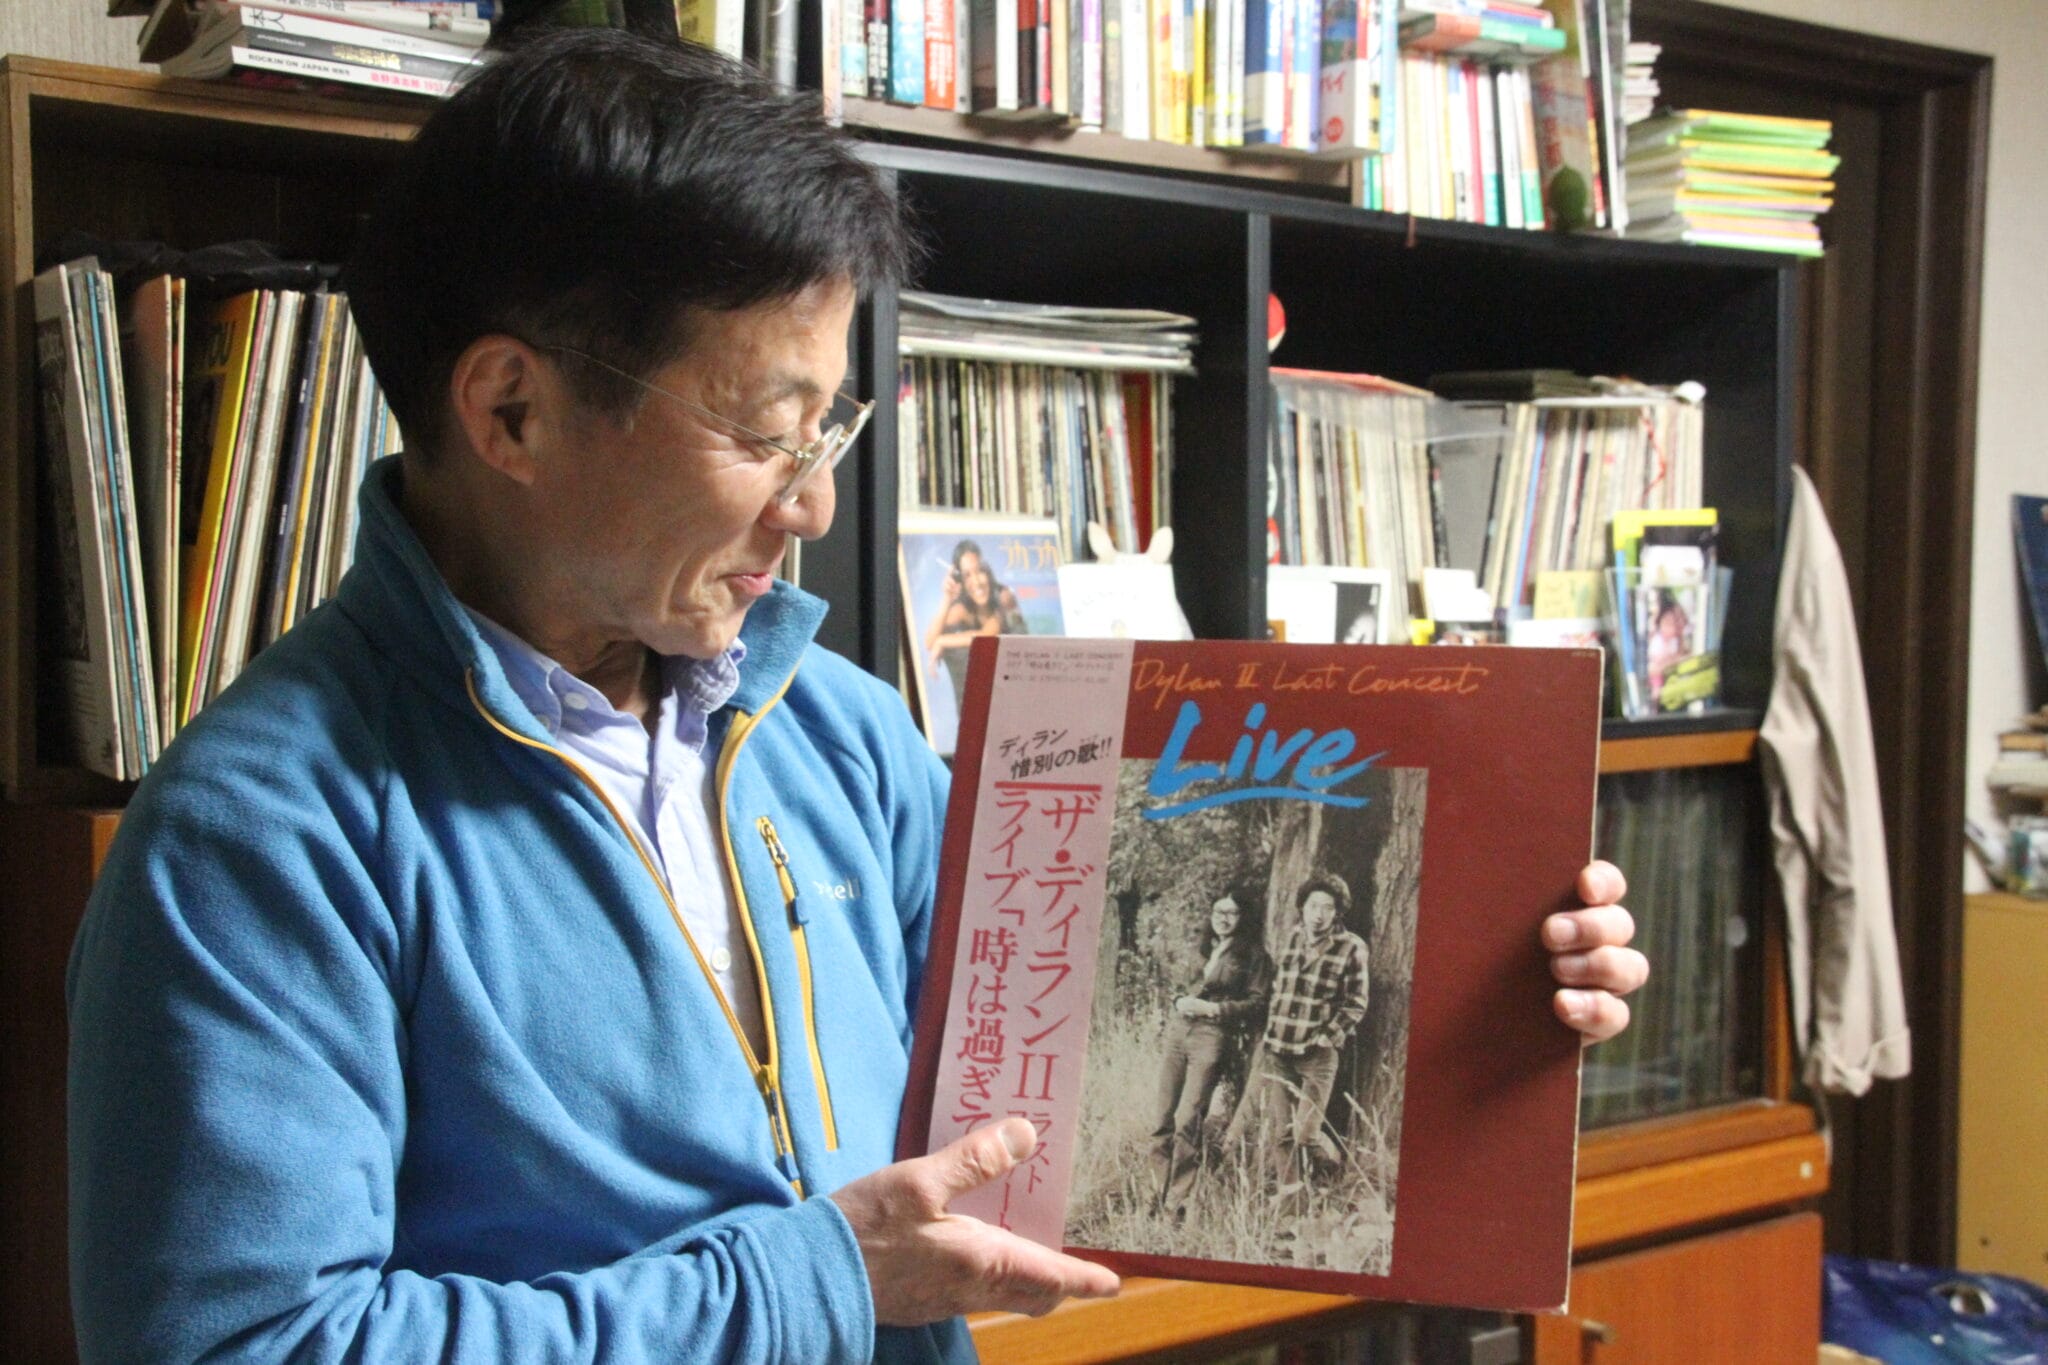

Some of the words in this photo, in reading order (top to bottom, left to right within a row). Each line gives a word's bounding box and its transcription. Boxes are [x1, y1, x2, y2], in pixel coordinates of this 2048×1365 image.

[1133, 659, 1222, 709] Dylan
[1272, 661, 1345, 691] Last
[999, 729, 1069, 758] ディラン
[1147, 700, 1388, 797] Live
